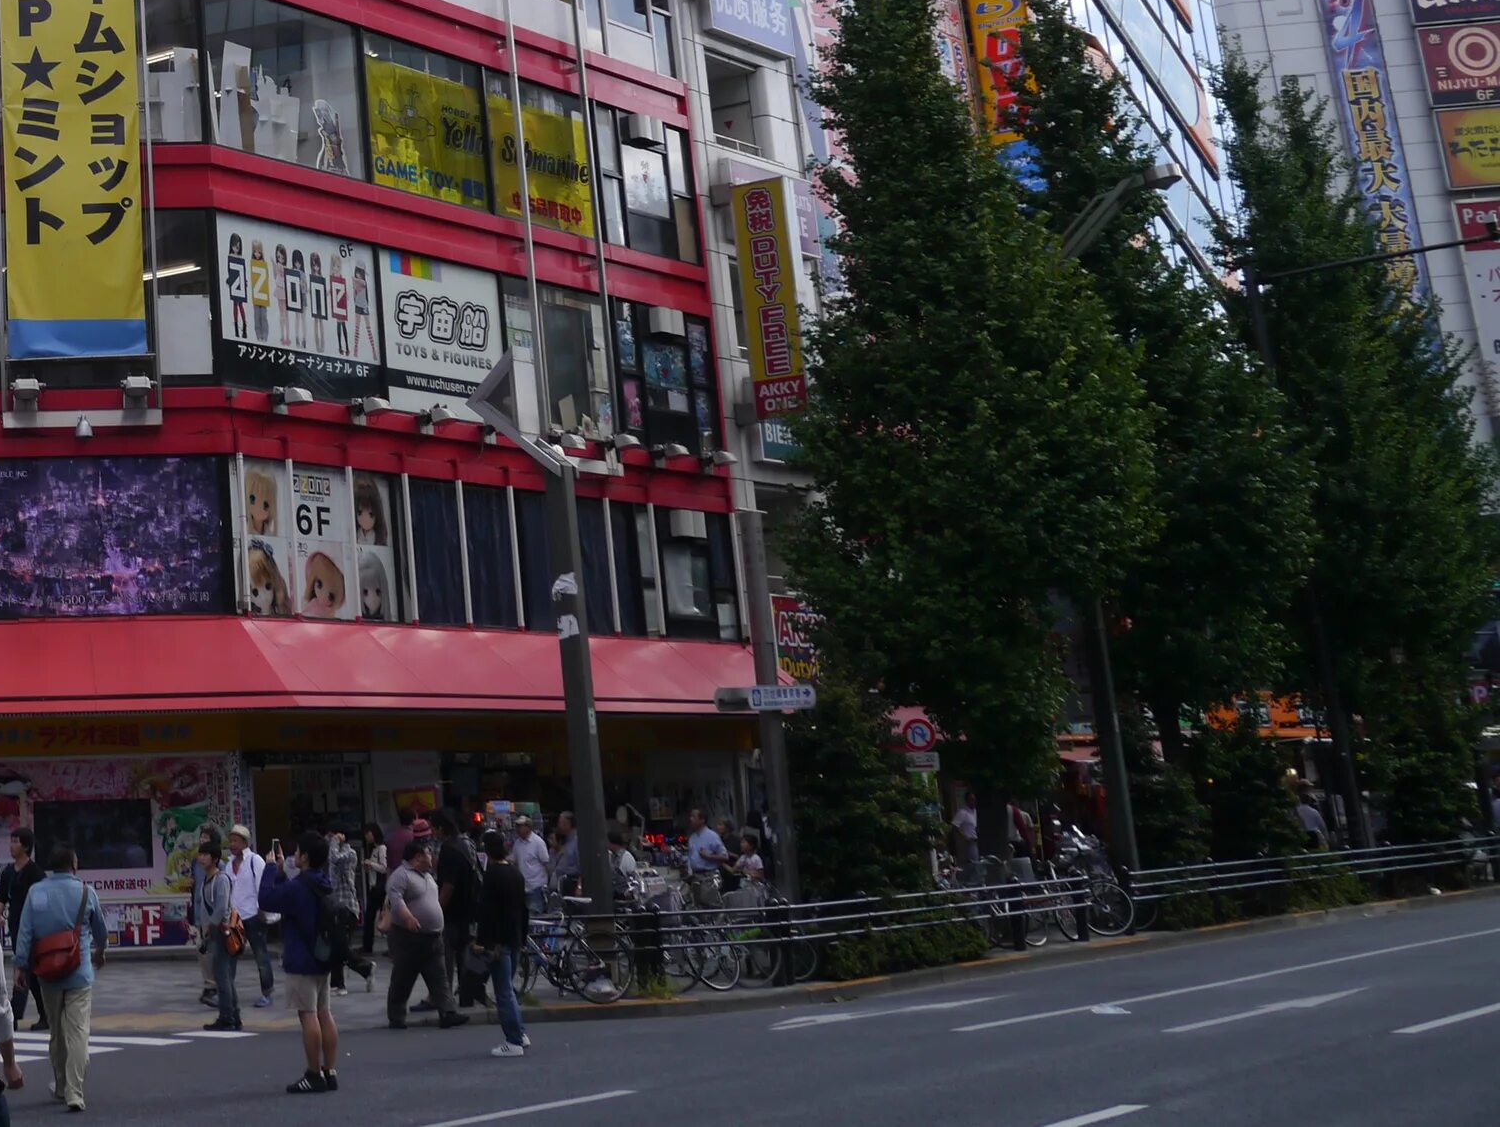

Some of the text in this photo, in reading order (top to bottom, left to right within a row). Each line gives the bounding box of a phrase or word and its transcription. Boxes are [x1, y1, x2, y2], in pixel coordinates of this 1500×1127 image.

[1476, 89, 1495, 102] 6F
[1343, 68, 1403, 193] 国内最大
[743, 188, 776, 234] 免税
[338, 242, 355, 259] 6F
[227, 256, 349, 323] azone
[394, 288, 490, 352] 宇宙船
[750, 236, 791, 377] DUTY FREE
[237, 343, 370, 377] アゾンインターナショナル 6F
[395, 341, 493, 370] TOYS & FIGURES
[758, 379, 802, 397] AKKY
[296, 503, 331, 536] 6F
[124, 904, 162, 926] 地下
[132, 924, 162, 946] 1F
